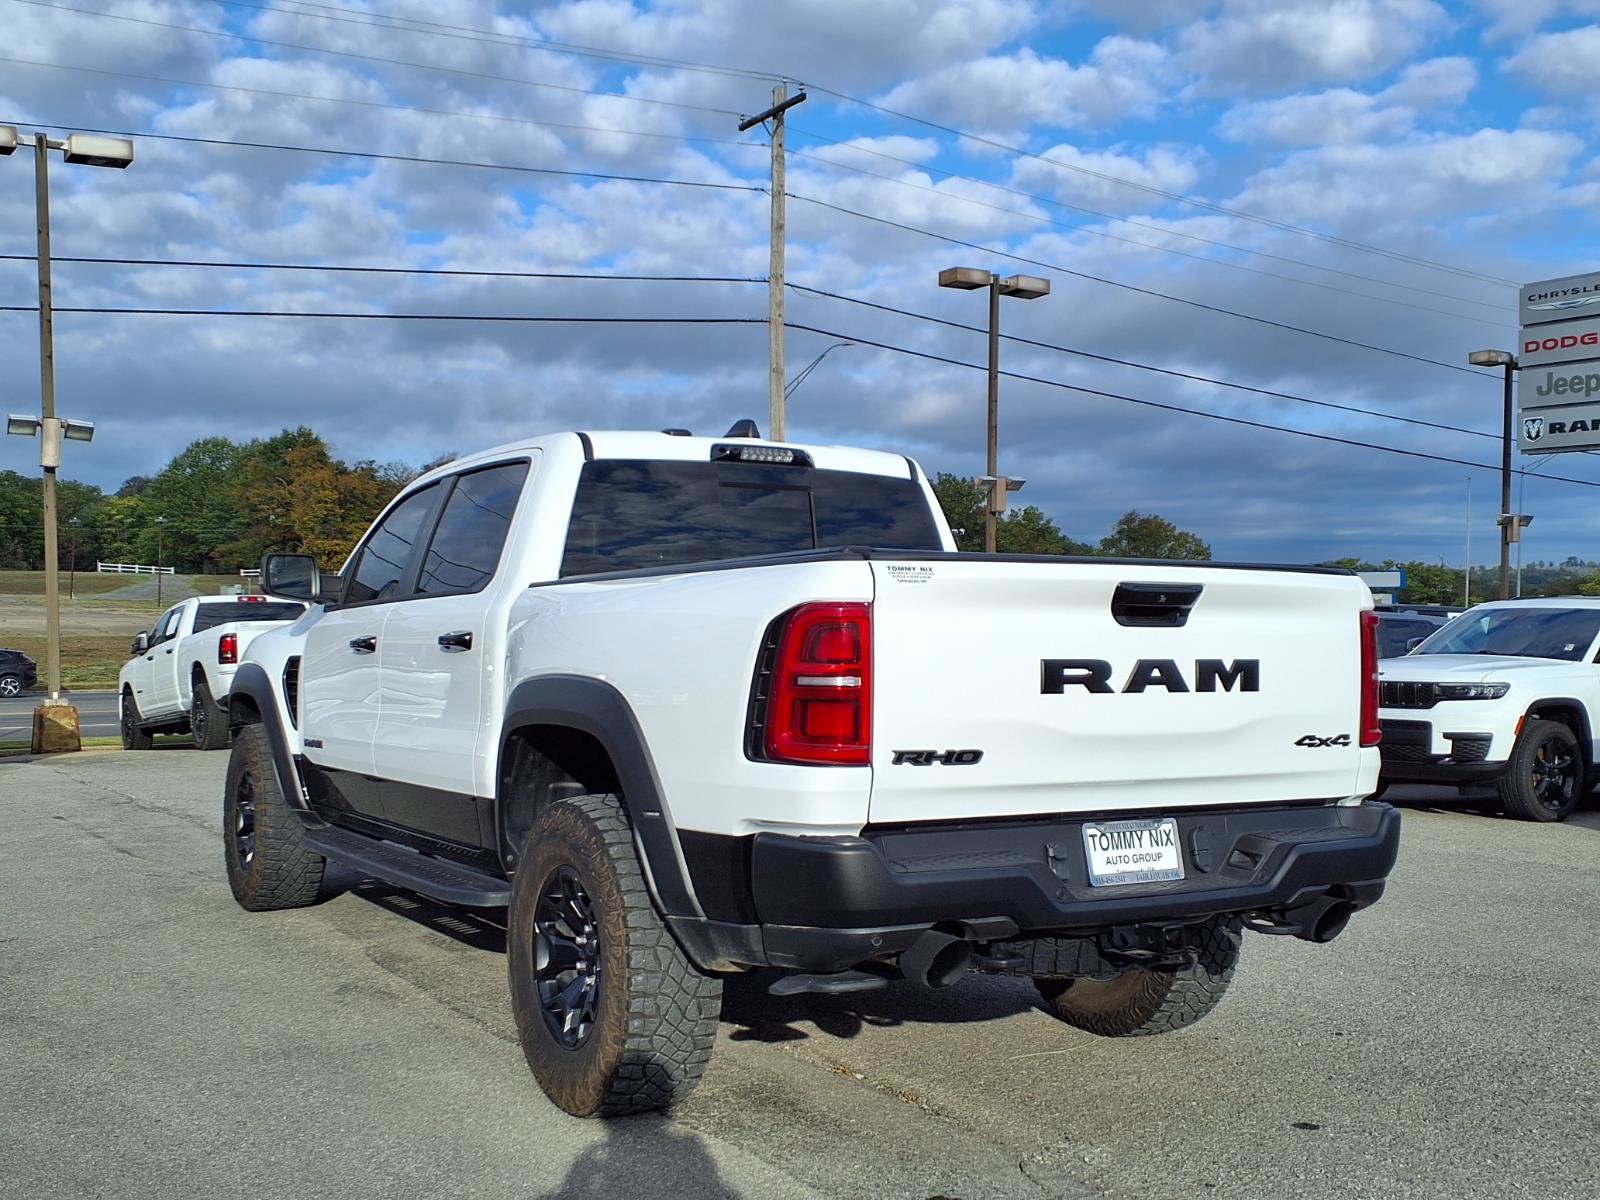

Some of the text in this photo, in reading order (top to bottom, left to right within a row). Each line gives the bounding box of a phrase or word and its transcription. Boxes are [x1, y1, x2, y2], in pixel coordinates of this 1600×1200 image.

[1524, 332, 1598, 353] DODG
[1536, 371, 1600, 397] Jeep
[1040, 659, 1260, 694] RAM
[1294, 734, 1351, 748] 4x4
[891, 749, 984, 766] RHO
[1089, 829, 1174, 852] TOMMY NIX
[1106, 852, 1163, 865] AUTO GROUP
